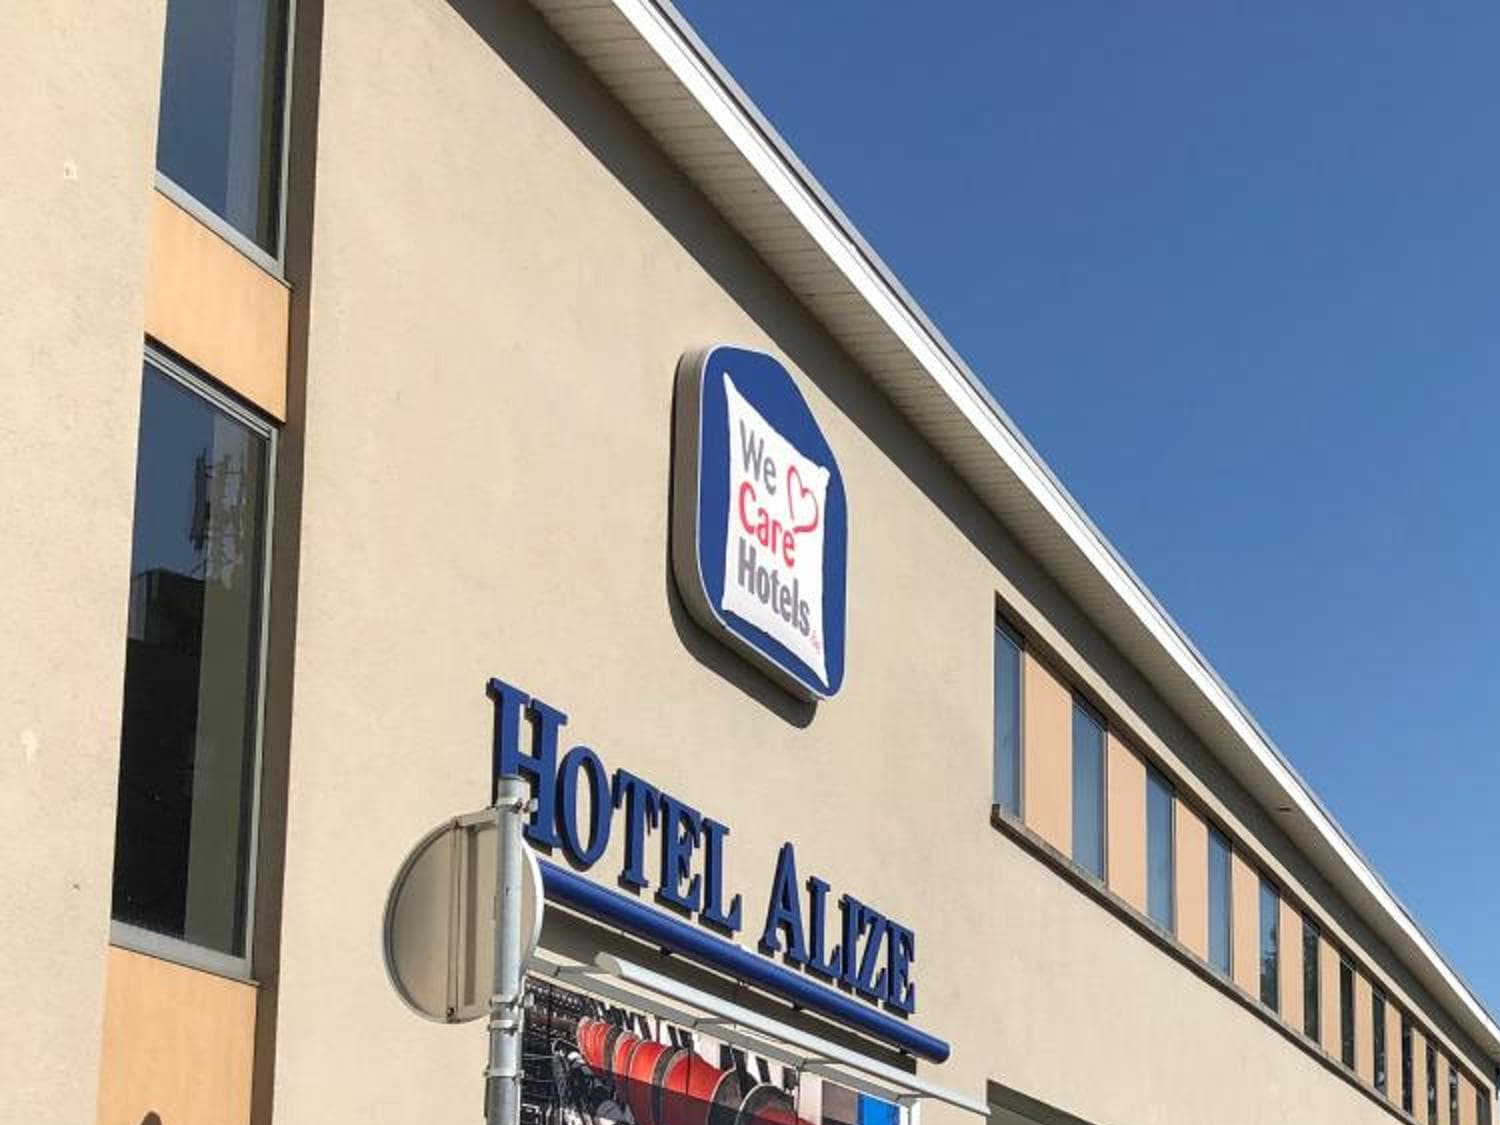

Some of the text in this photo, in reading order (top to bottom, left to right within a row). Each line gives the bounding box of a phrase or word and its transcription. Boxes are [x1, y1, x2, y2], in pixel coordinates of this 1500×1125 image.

[740, 419, 777, 495] We
[738, 481, 796, 568] Care
[737, 536, 810, 637] Hotels
[487, 677, 916, 1013] HOTEL ALIZE
